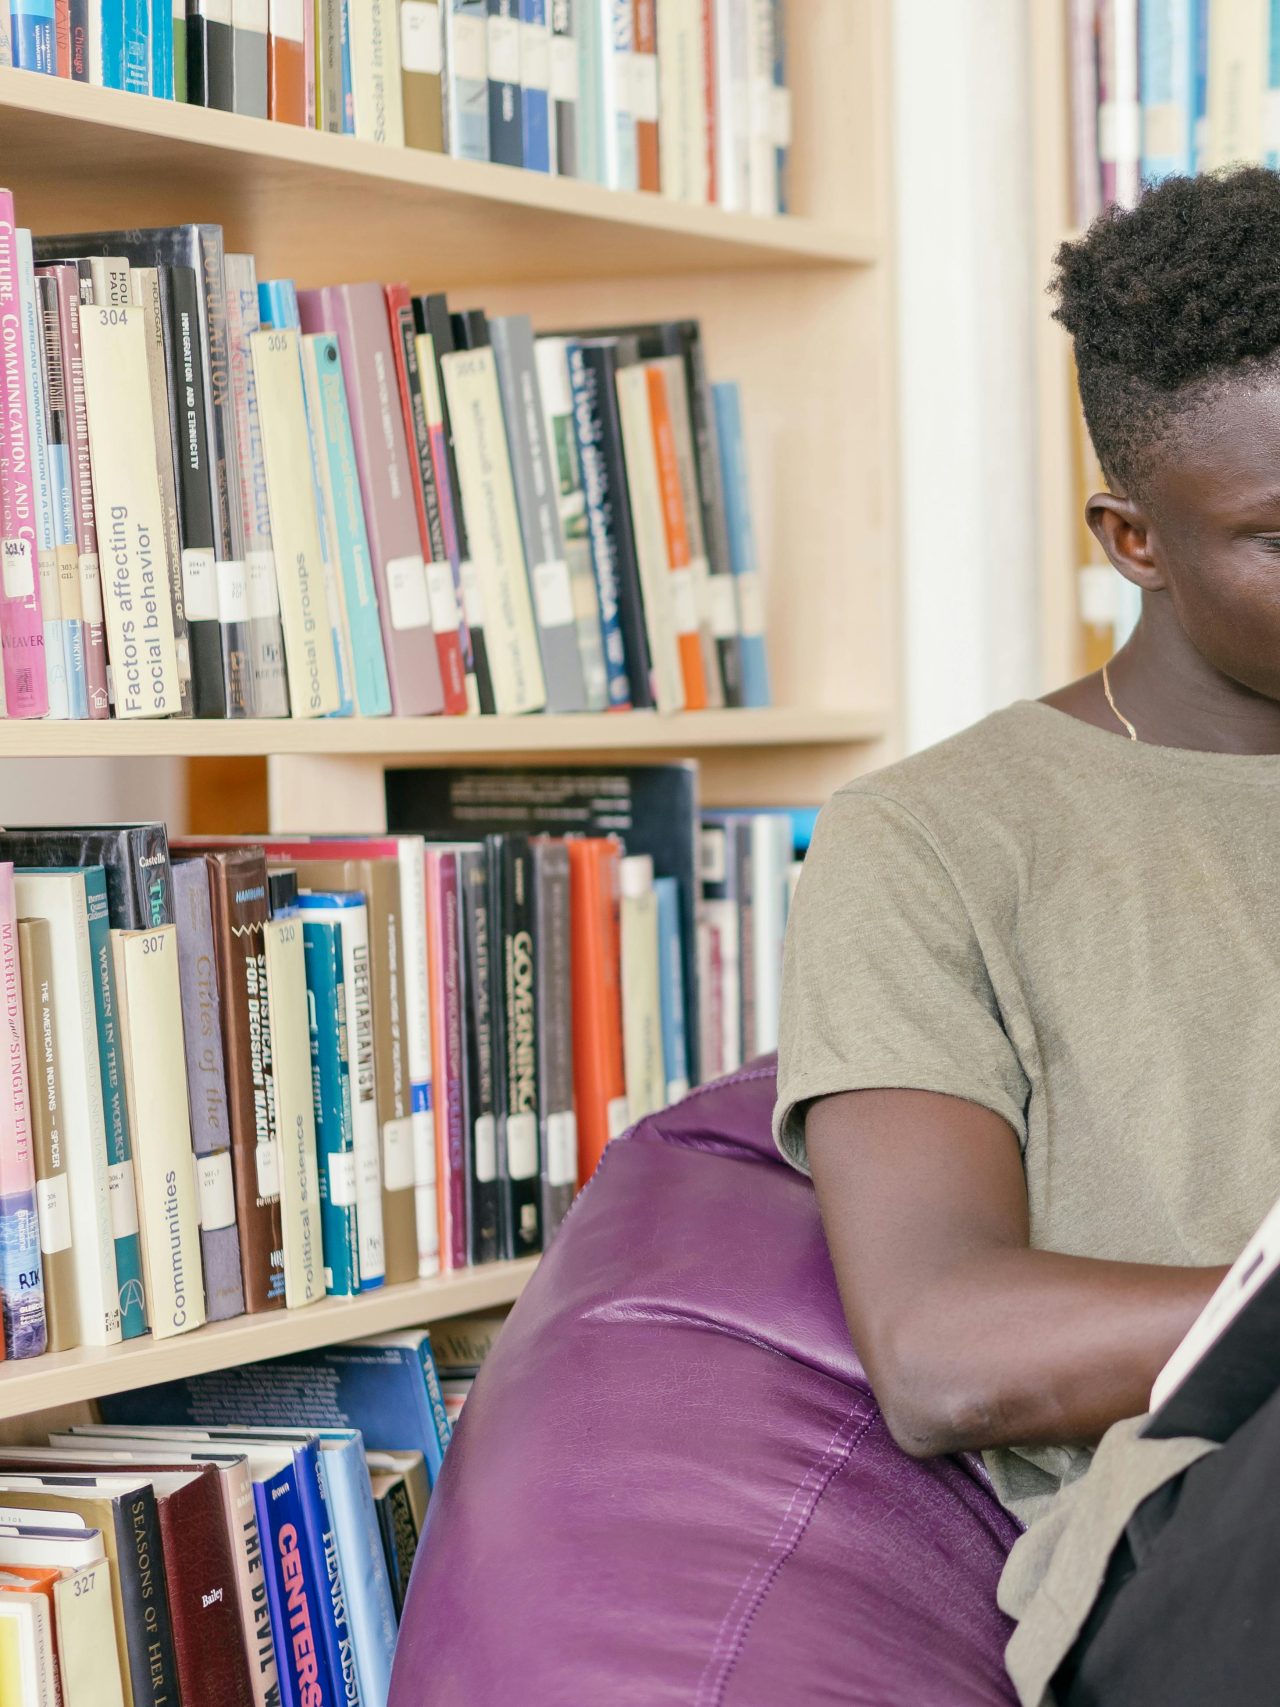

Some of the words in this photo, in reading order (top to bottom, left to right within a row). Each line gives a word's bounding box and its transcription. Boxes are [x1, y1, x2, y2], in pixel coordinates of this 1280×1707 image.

[74, 26, 84, 74] Chicago
[371, 73, 387, 143] Social
[26, 301, 39, 368] AMERICAN
[69, 295, 79, 334] Meadows
[99, 309, 129, 326] 304
[152, 281, 163, 348] HOLDGATE
[203, 240, 229, 406] POPULATION
[181, 313, 193, 382] IMMIGRATION
[267, 335, 288, 351] 305
[47, 360, 65, 412] TELEVISION
[71, 357, 88, 440] INFORMATION
[185, 386, 196, 407] AND
[1, 314, 26, 473] COMMUNICATION
[14, 481, 30, 519] AND
[31, 372, 48, 480] COMMUNICATION
[187, 411, 199, 470] ETHNICITY
[39, 483, 49, 496] IN
[40, 499, 49, 509] A
[61, 487, 71, 531] GEORGE
[77, 445, 94, 528] TECHNOLOGY
[41, 511, 53, 551] GLOBA
[61, 572, 74, 580] GIL
[110, 505, 132, 616] affecting
[137, 523, 162, 629] behavior
[169, 518, 182, 601] PERSPECTIVE
[174, 603, 184, 620] OF
[296, 553, 316, 635] groups
[2, 634, 44, 649] WEAVER
[72, 631, 82, 672] NORTON
[121, 623, 142, 711] Factors
[146, 636, 165, 709] social
[301, 641, 321, 709] Social
[139, 853, 166, 868] Castells
[148, 878, 164, 925] The
[142, 935, 165, 954] 307
[279, 926, 296, 944] 320
[1, 923, 19, 1017] MARRIED
[41, 980, 50, 1003] THE
[98, 946, 112, 1017] WOMEN
[197, 956, 212, 1036] Cities
[246, 956, 260, 994] FOR
[7, 1017, 20, 1041] and
[42, 1007, 53, 1062] AMERICAN
[104, 1022, 114, 1043] IN
[248, 998, 264, 1085] DECISION
[353, 945, 375, 1103] LIBERTARIANISM
[513, 931, 536, 1114] GOVERNING
[9, 1043, 26, 1112] SINGLE
[45, 1066, 57, 1111] INDIANS
[107, 1047, 118, 1088] THE
[199, 1049, 219, 1073] of
[109, 1092, 124, 1162] WORKP
[207, 1087, 224, 1129] the
[14, 1118, 29, 1161] LIFE
[50, 1130, 60, 1168] SPICER
[295, 1115, 310, 1201] science
[164, 1170, 186, 1327] Communities
[301, 1210, 315, 1300] Political
[131, 1501, 153, 1598] SEASONS
[242, 1515, 263, 1574] THE
[73, 1572, 96, 1597] 327
[201, 1586, 224, 1609] Bailey
[322, 1529, 348, 1629] HENRY
[144, 1606, 158, 1633] OF
[250, 1581, 277, 1674] DEVIL
[147, 1642, 166, 1689] HER
